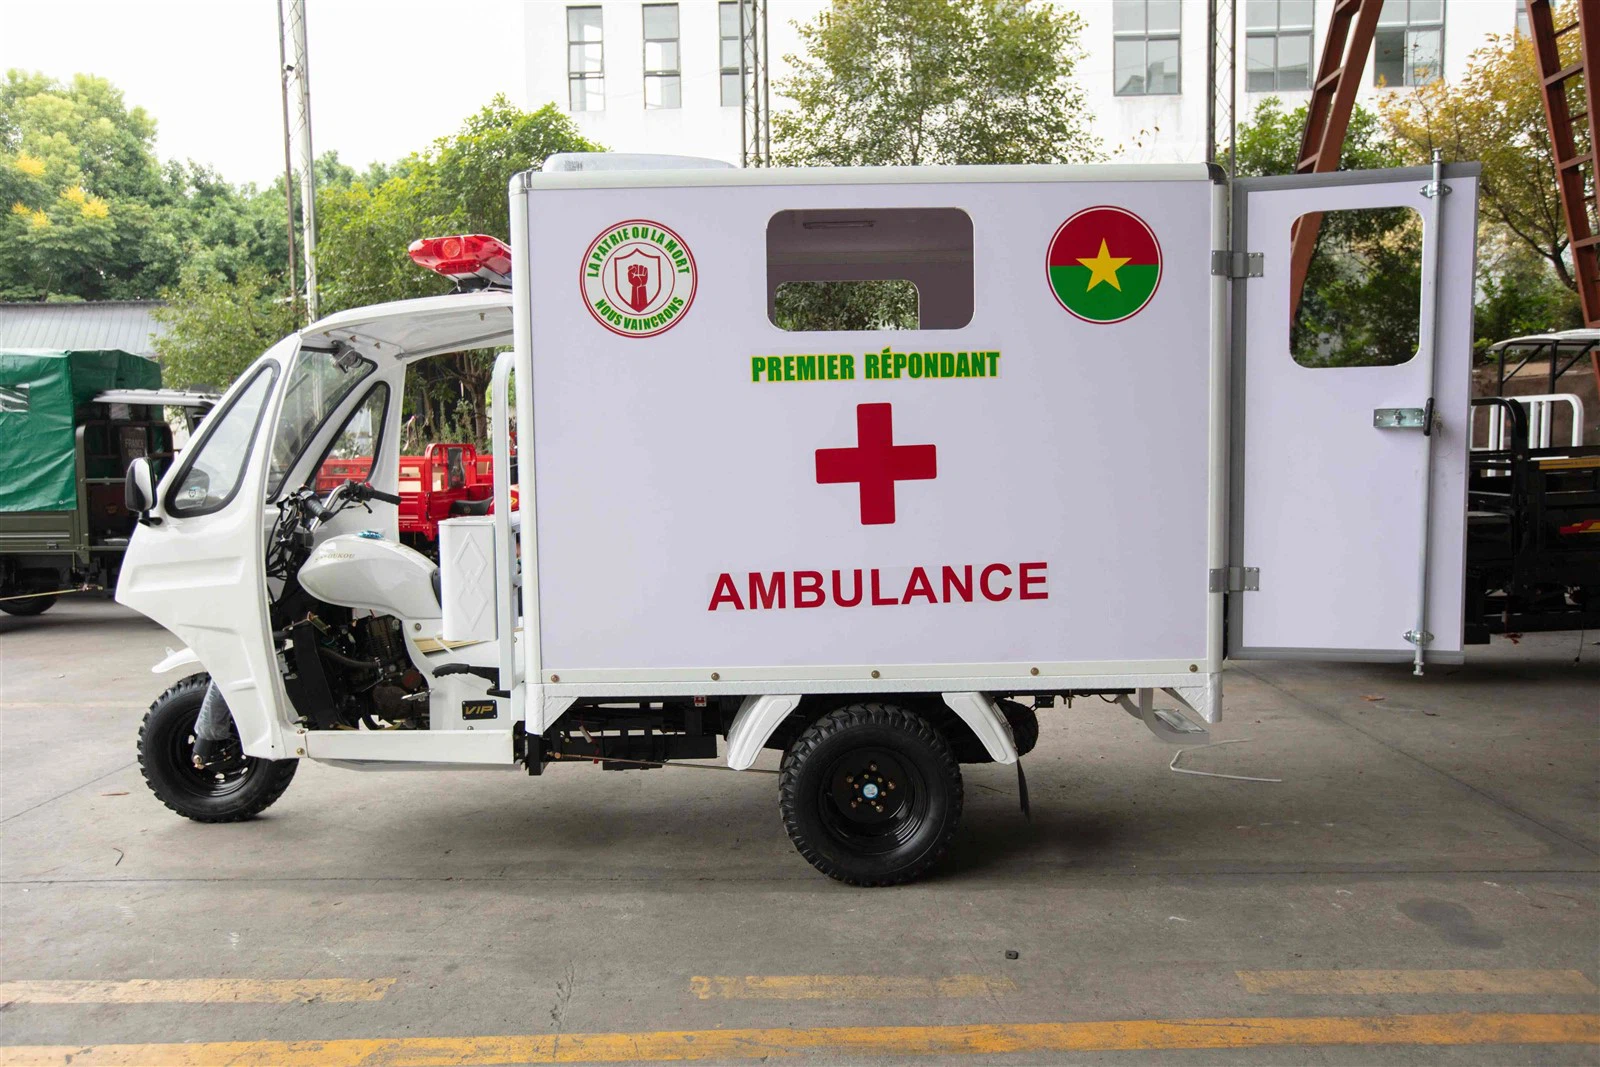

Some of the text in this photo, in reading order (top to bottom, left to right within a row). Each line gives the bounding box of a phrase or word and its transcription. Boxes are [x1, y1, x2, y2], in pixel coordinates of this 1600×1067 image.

[587, 226, 691, 278] LA PATRIE OU LA MORT
[594, 296, 685, 331] NOUS VAINCRONS
[751, 346, 1001, 382] PREMIER RÉPONDANT
[708, 562, 1049, 611] AMBULANCE
[465, 705, 494, 715] VIP
